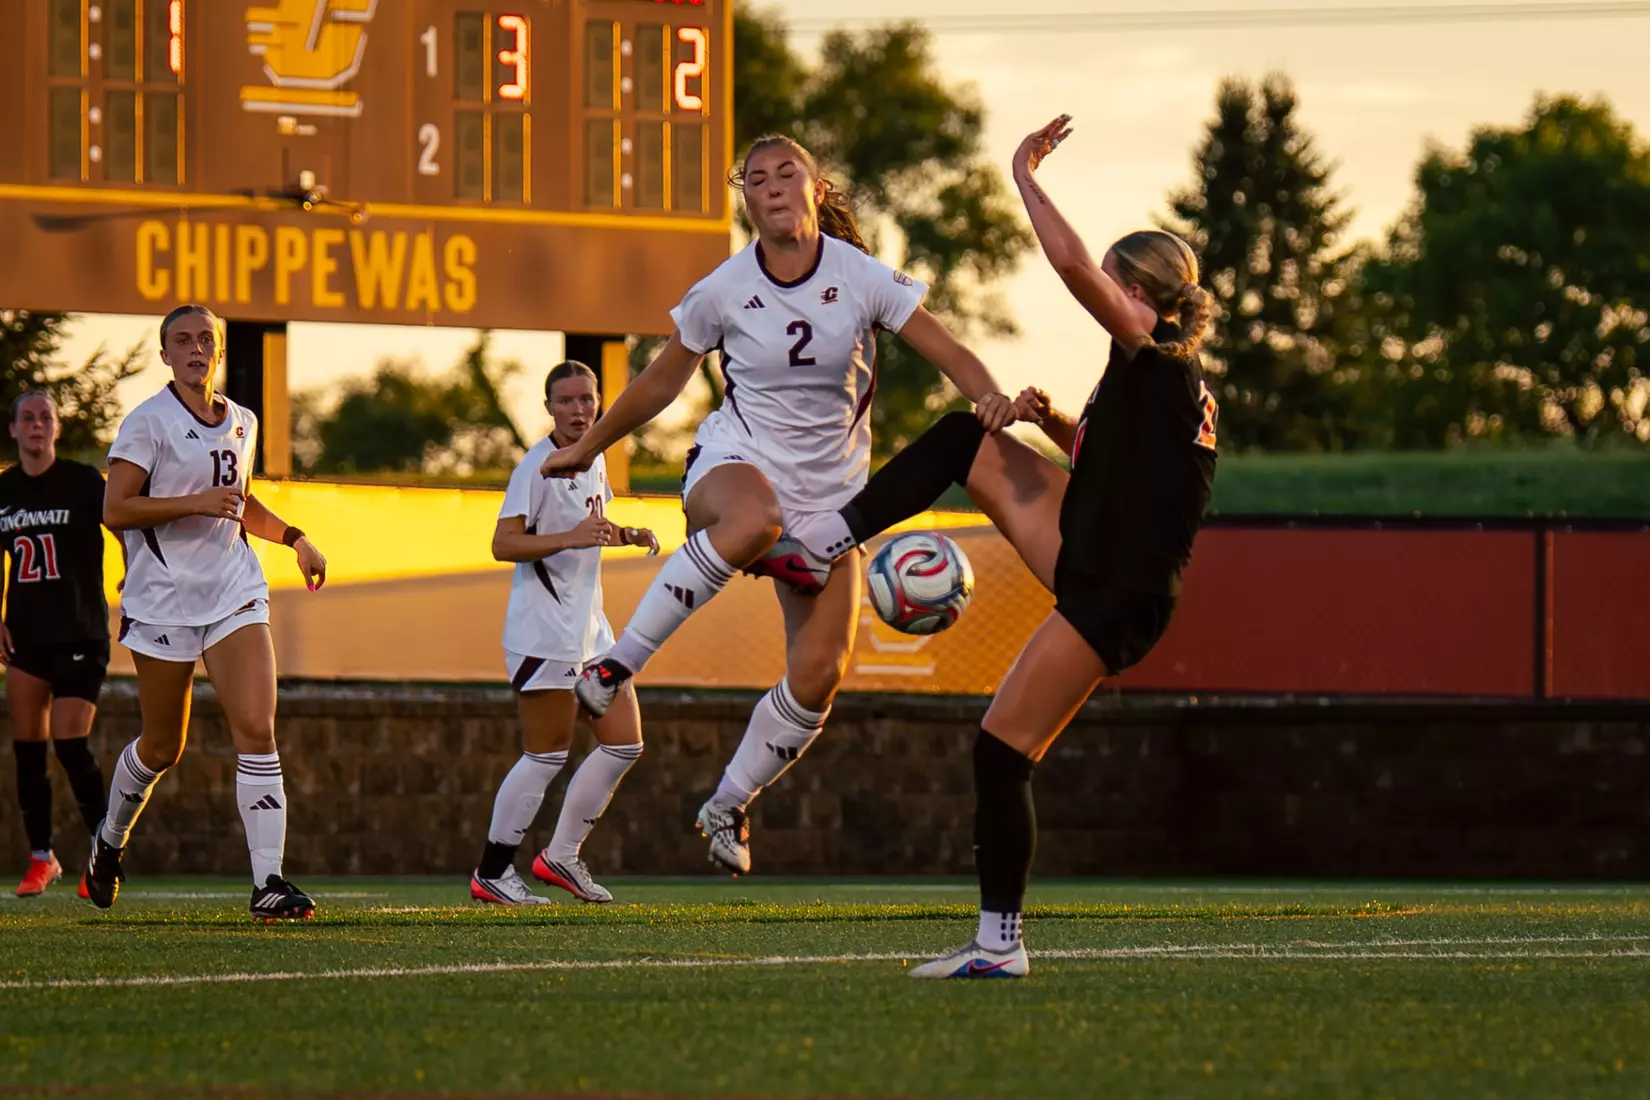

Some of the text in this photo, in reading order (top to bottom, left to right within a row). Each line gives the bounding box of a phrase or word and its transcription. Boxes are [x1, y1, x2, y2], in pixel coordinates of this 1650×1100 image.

[420, 25, 438, 78] 1
[498, 14, 528, 99] 3
[674, 26, 705, 110] 2
[419, 123, 440, 175] 2
[136, 219, 477, 313] CHIPPEWAS
[785, 319, 817, 367] 2
[209, 449, 238, 487] 13
[14, 533, 61, 583] 21
